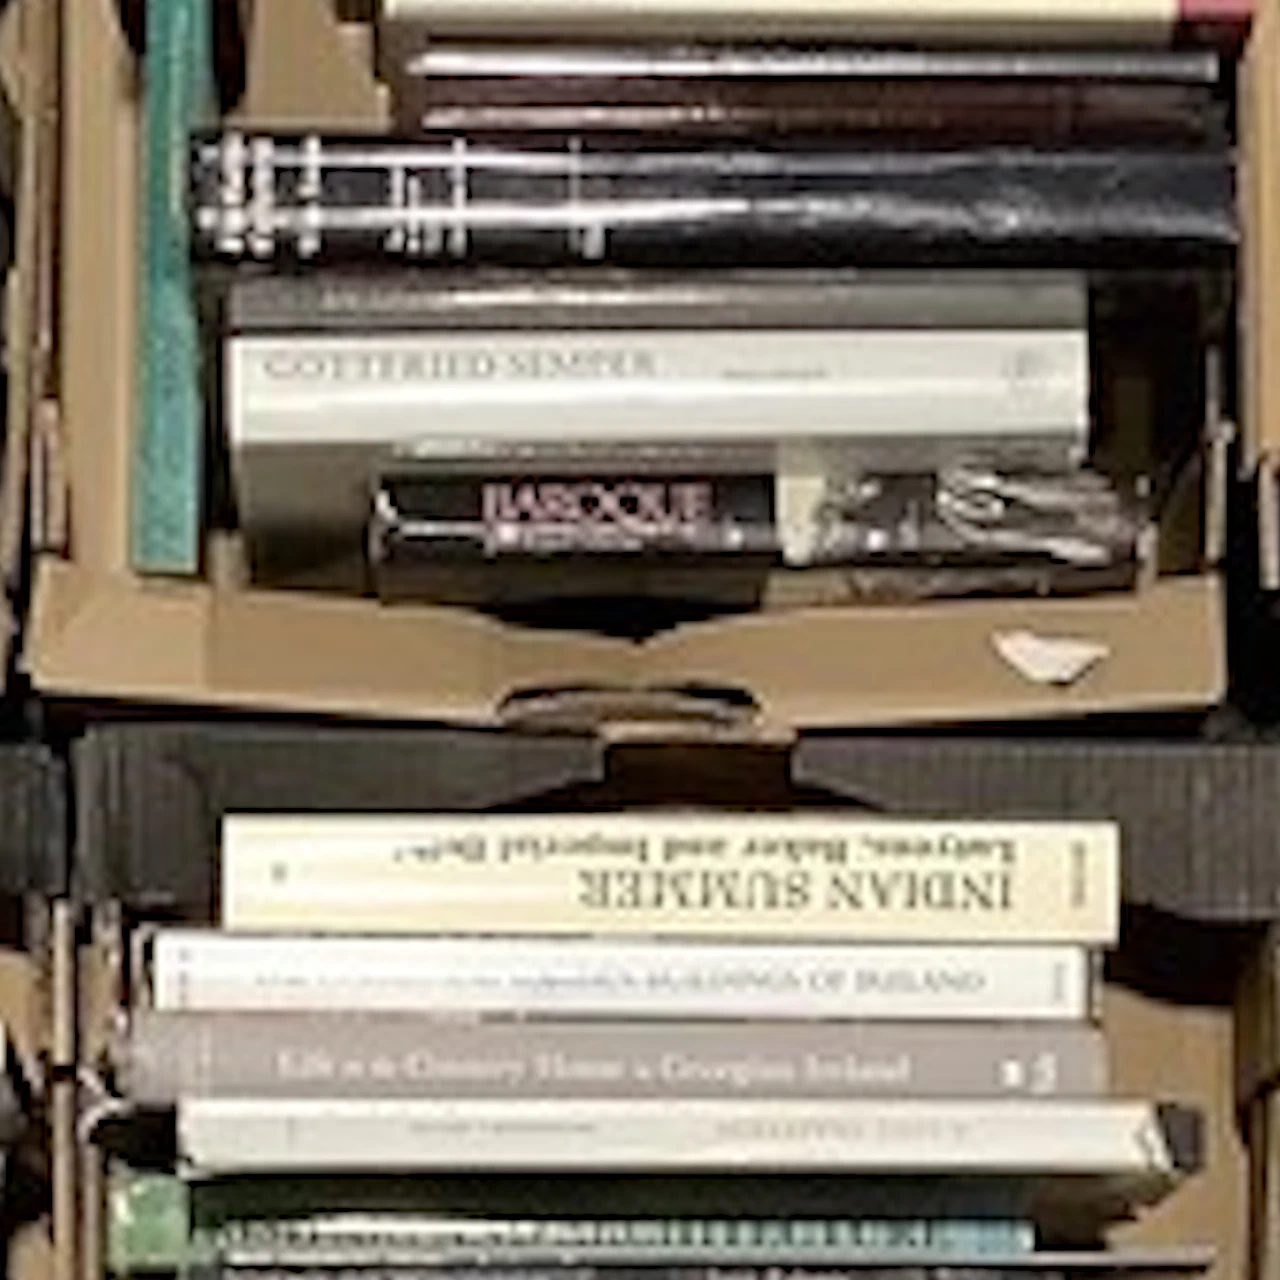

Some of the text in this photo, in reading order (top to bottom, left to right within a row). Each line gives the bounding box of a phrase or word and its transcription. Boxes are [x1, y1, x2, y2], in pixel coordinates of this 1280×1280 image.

[501, 346, 658, 380] SEMPER
[482, 480, 713, 528] BAROQUE
[502, 828, 650, 866] Imperial
[662, 835, 731, 865] and
[742, 835, 849, 865] Baker
[577, 868, 1012, 912] INDIAN SUMMER
